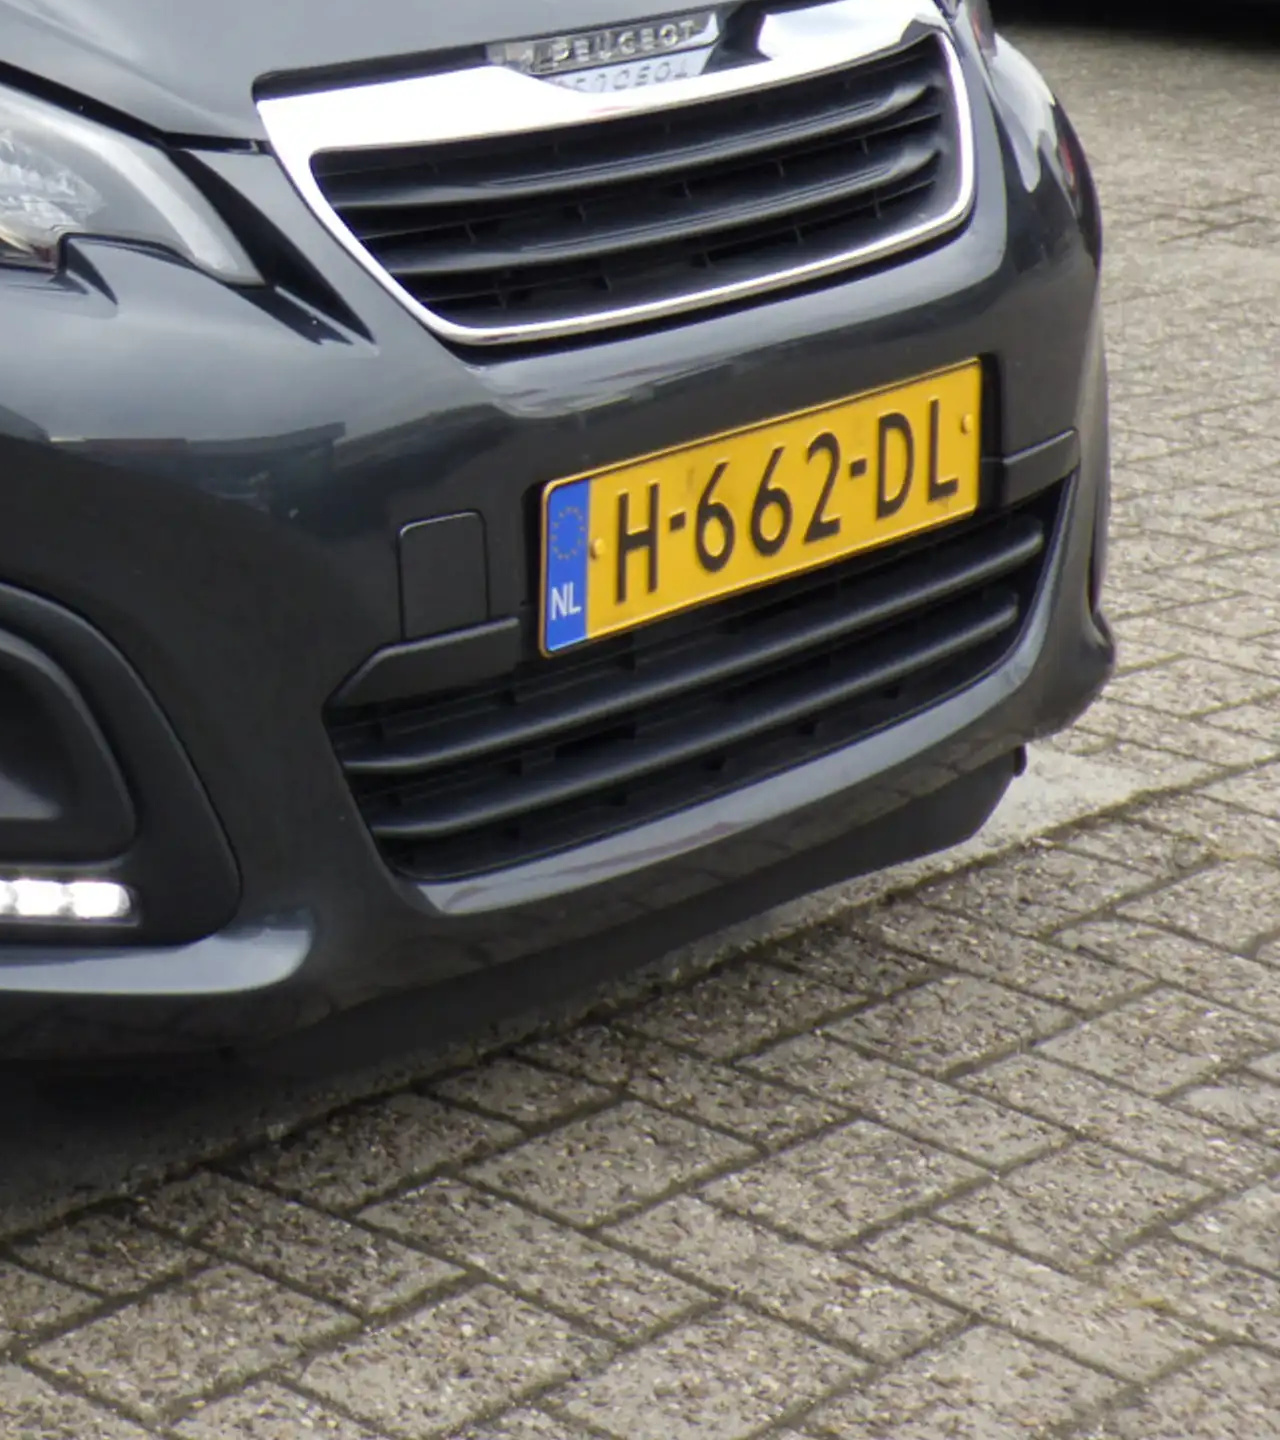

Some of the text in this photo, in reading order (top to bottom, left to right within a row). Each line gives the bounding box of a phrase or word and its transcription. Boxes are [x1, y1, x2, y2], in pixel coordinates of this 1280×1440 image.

[551, 19, 695, 68] PEUGEOT
[616, 398, 960, 605] H-662-DL
[551, 581, 582, 621] NL
